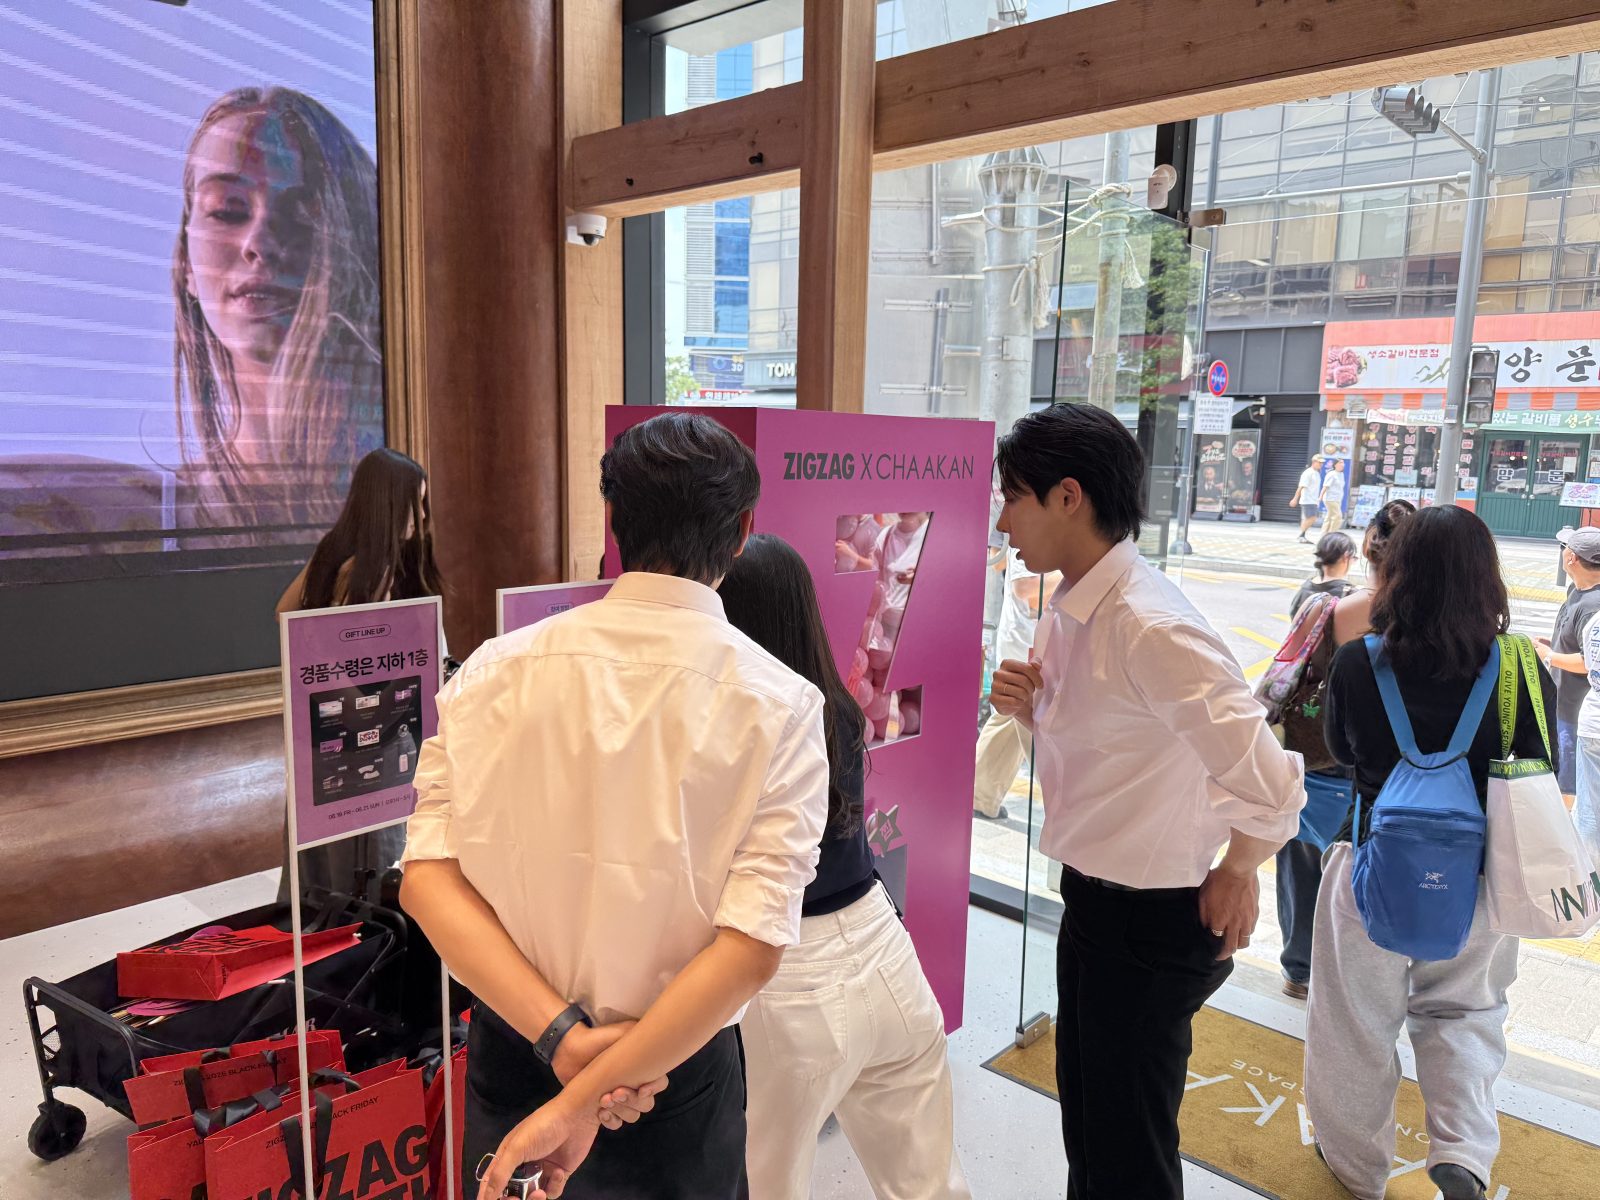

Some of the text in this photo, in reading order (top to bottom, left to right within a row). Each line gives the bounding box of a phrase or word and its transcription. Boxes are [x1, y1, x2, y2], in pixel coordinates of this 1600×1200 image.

[783, 452, 855, 481] ZIGZAG
[345, 627, 386, 639] GIFT LINE UP
[300, 648, 429, 685] 경품수령은 지하 1층
[1526, 660, 1536, 684] OLIVE
[1503, 670, 1513, 694] OLIVE
[258, 1058, 287, 1069] FRIAY
[350, 1096, 380, 1113] FRIDAY
